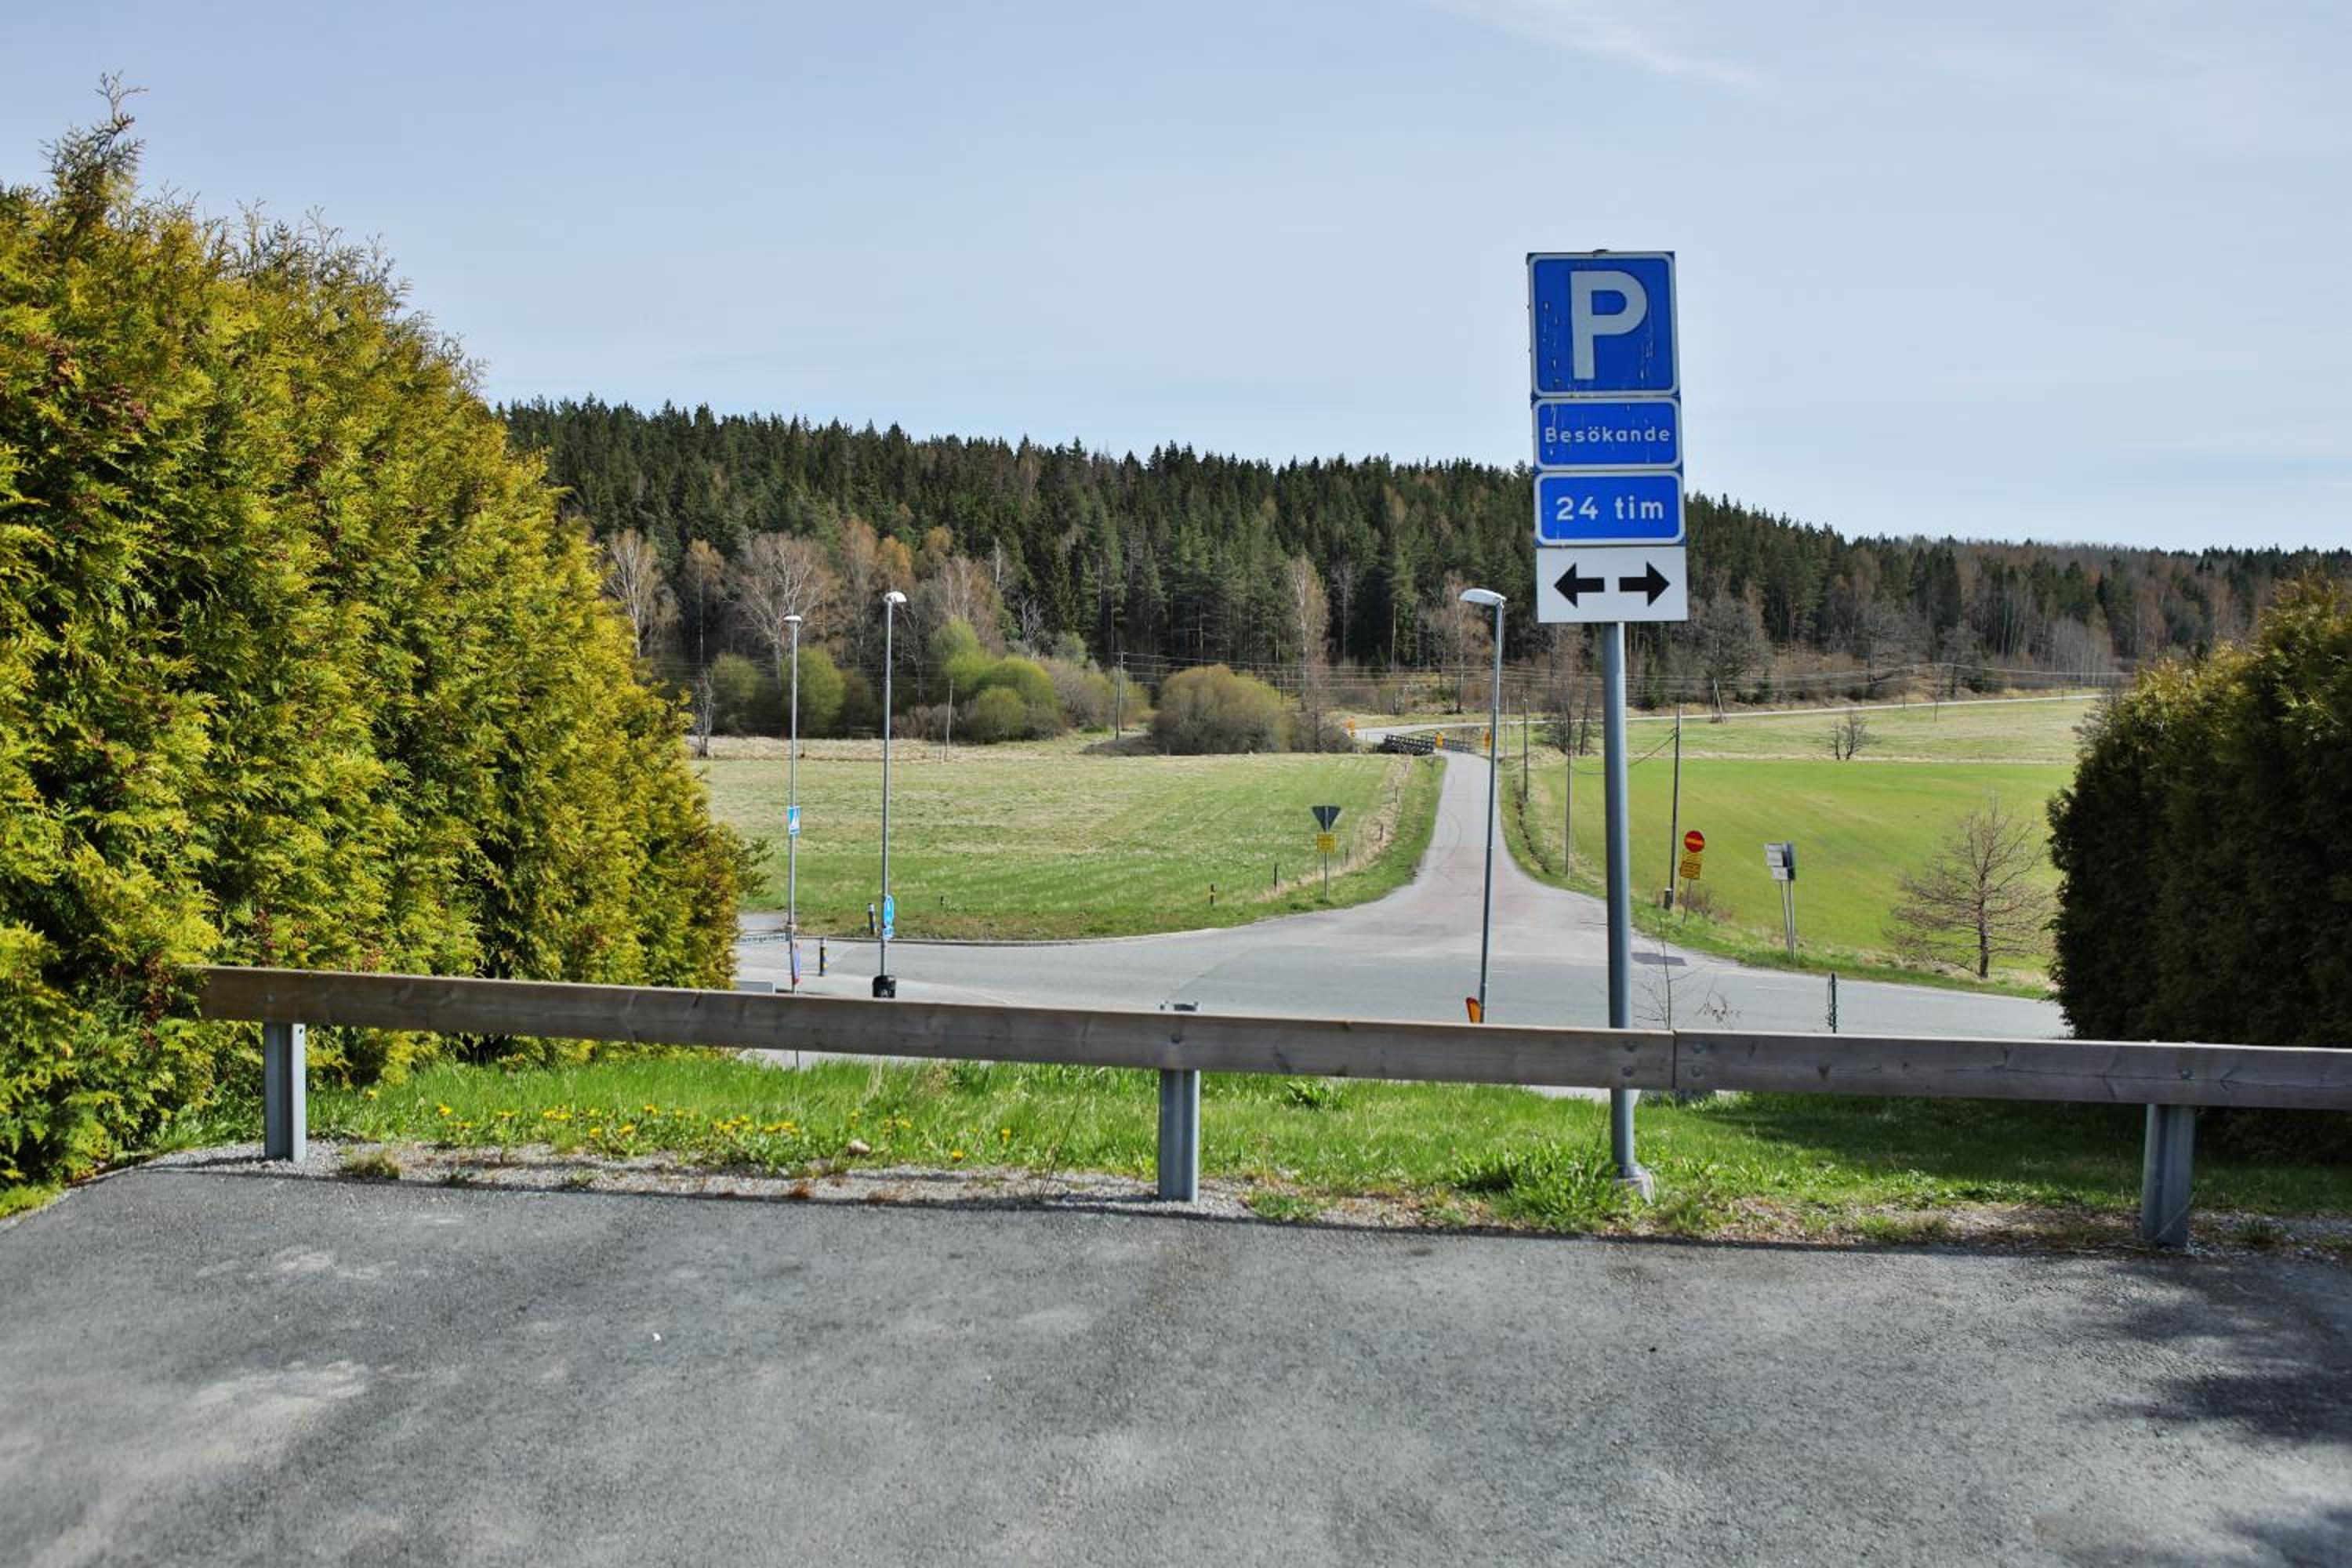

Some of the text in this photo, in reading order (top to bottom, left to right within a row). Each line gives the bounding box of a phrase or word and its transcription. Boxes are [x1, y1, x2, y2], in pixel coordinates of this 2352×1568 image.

[1570, 270, 1647, 379] P
[1545, 426, 1671, 443] Besökande
[1556, 495, 1664, 521] 24 tim
